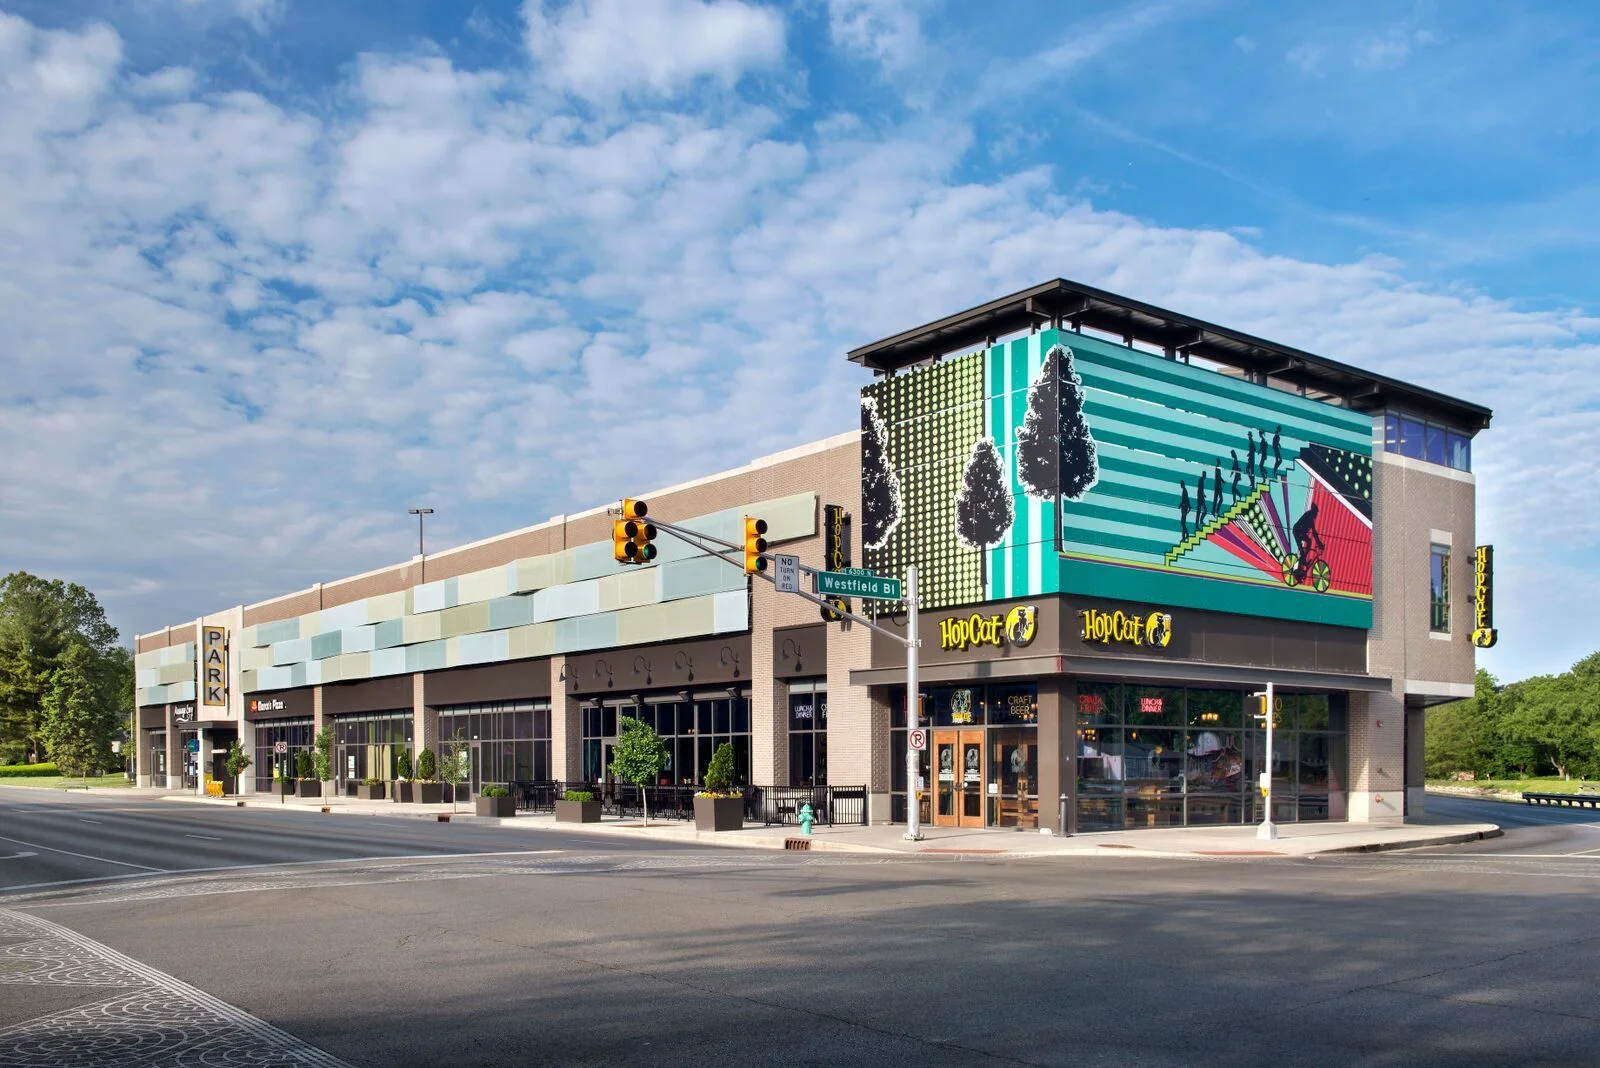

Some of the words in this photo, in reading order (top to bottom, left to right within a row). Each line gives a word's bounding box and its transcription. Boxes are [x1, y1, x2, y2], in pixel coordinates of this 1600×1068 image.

[781, 558, 793, 566] NO
[824, 576, 878, 593] Westfield
[883, 583, 895, 595] Bl
[1476, 547, 1487, 627] HopCat
[938, 613, 1003, 649] HopCat
[1083, 609, 1144, 645] HopCat
[208, 630, 222, 702] PARK
[1007, 695, 1032, 705] CRAFT
[1010, 705, 1030, 715] BEER
